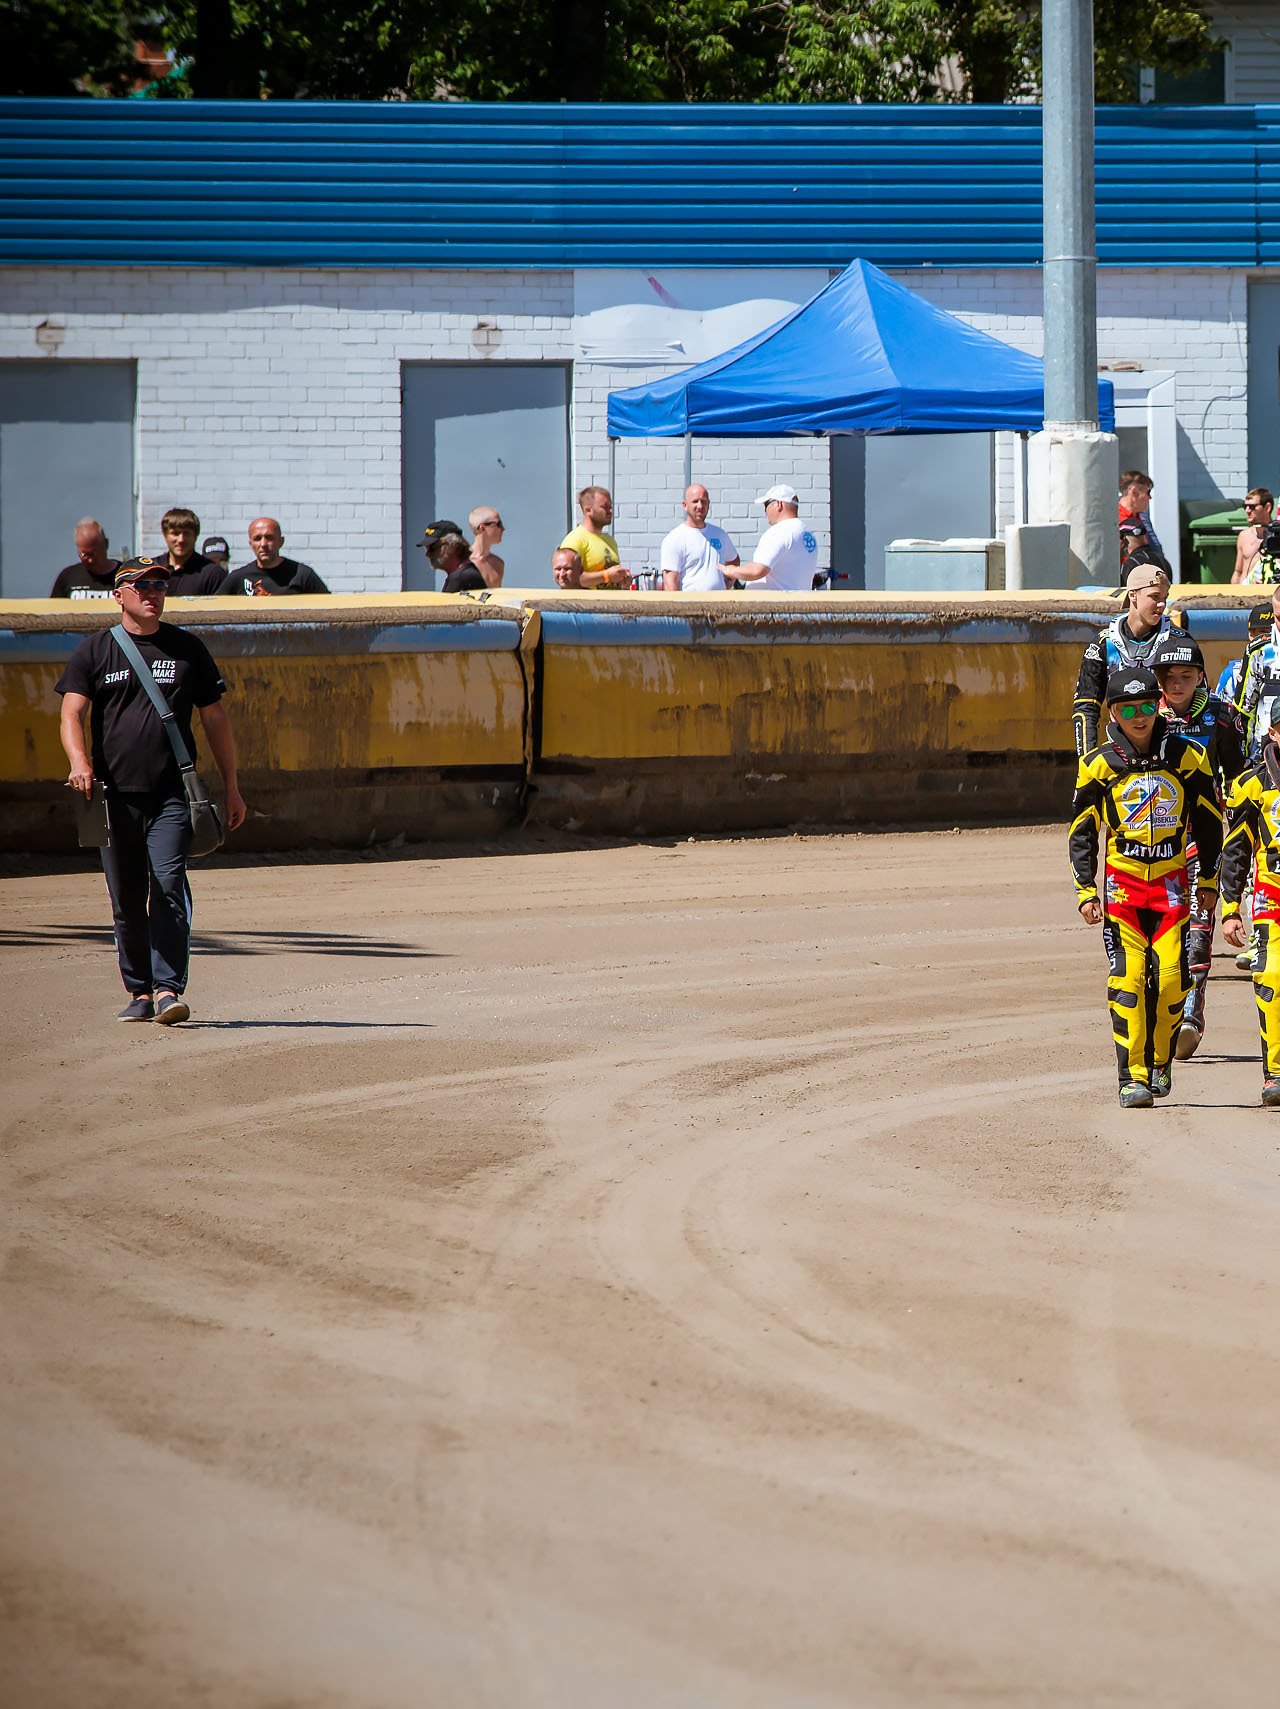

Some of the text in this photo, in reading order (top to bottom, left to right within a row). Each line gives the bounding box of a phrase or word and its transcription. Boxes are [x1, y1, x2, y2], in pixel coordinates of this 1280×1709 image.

[1160, 651, 1192, 663] ESTONIA
[152, 660, 176, 669] #LETS
[105, 669, 129, 684] STAFF
[152, 669, 176, 678] MAKE
[1123, 842, 1174, 858] LATVIJA
